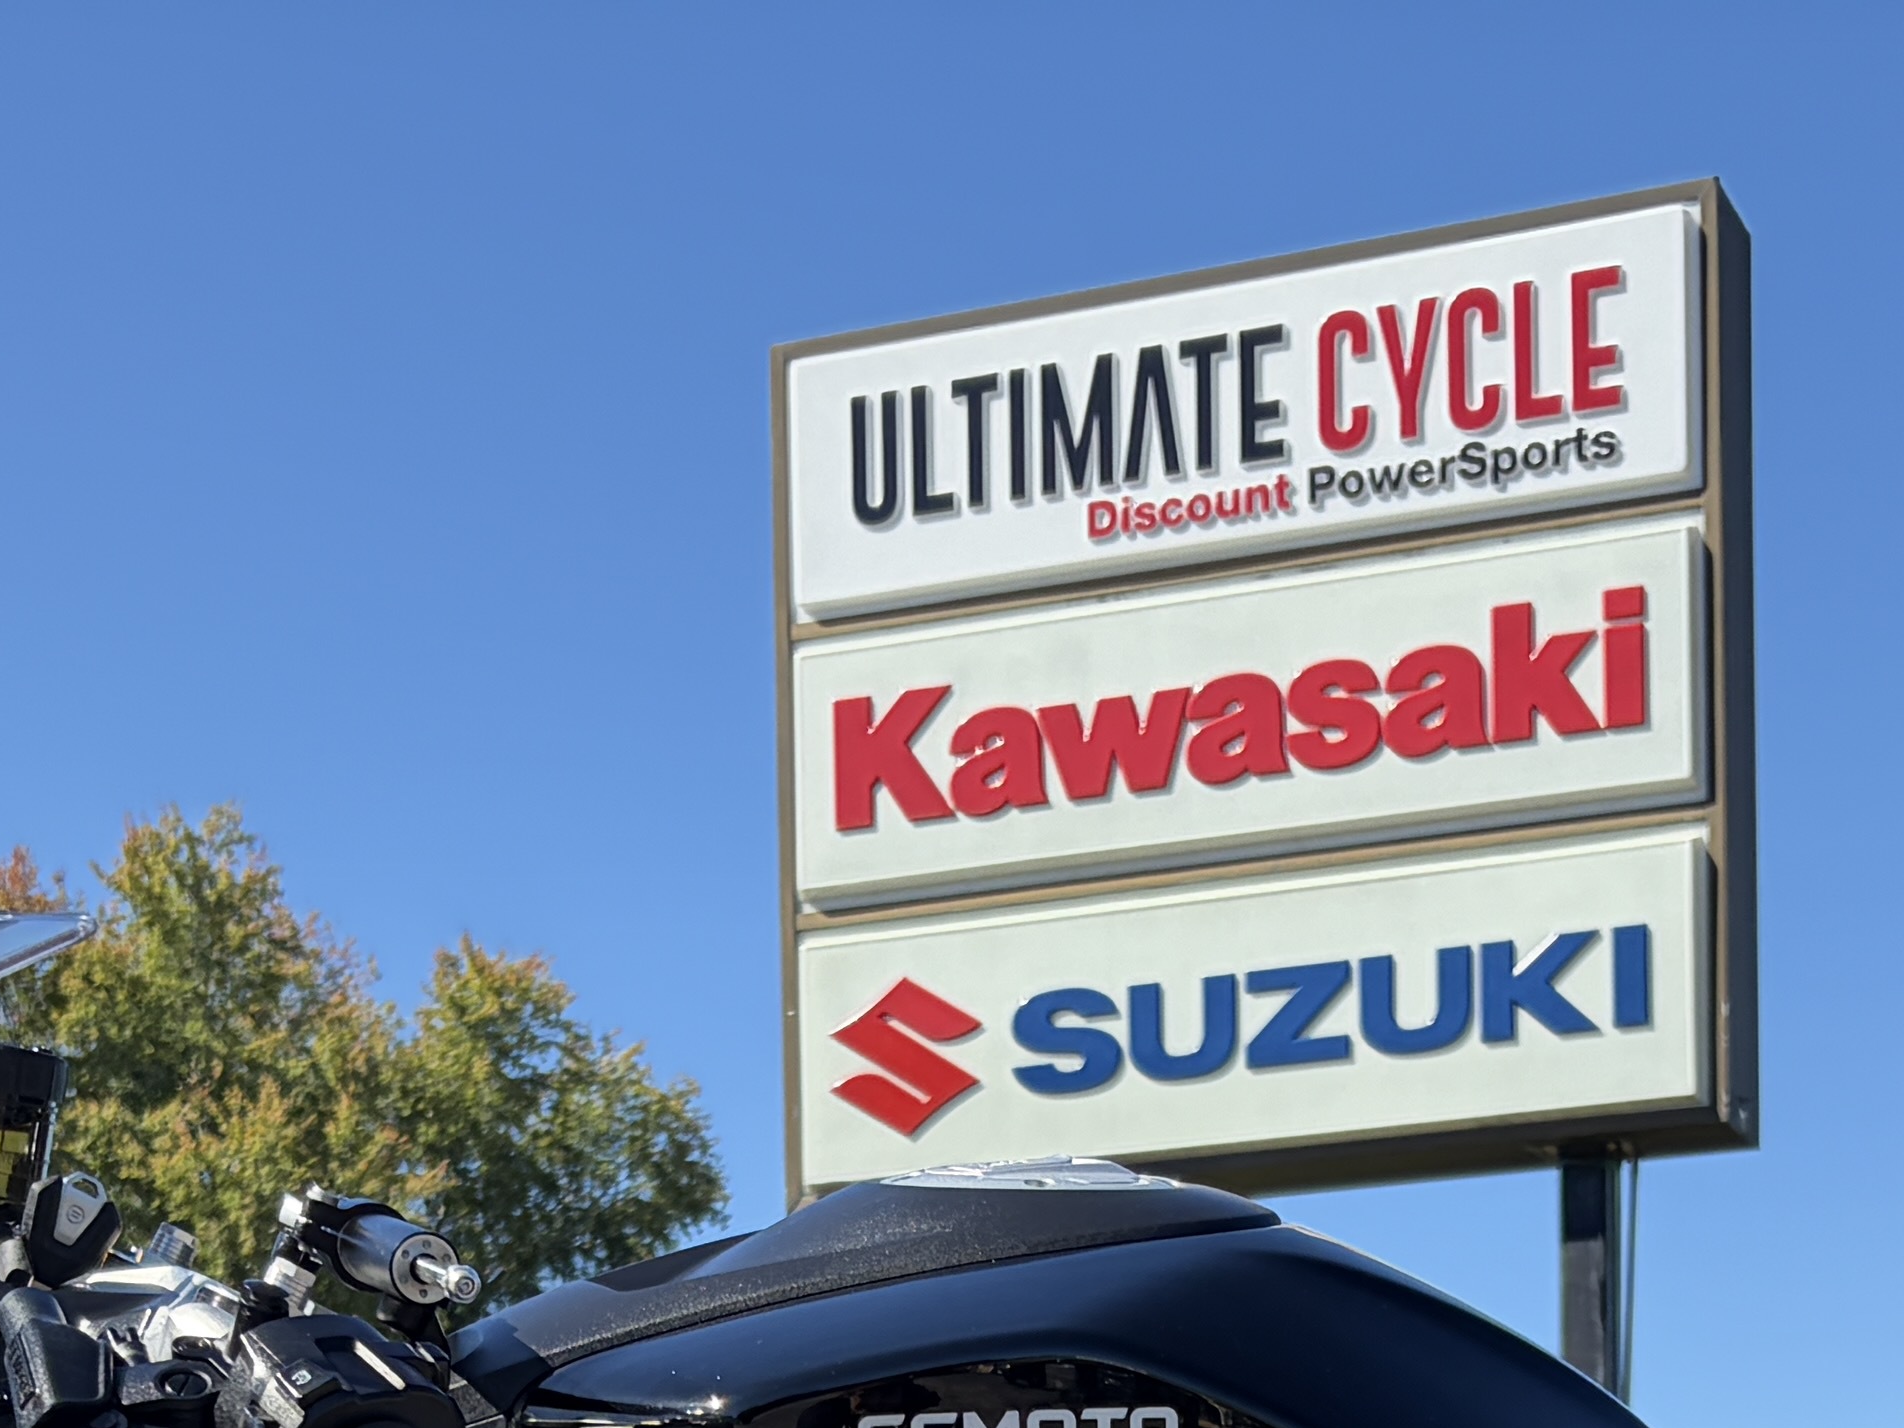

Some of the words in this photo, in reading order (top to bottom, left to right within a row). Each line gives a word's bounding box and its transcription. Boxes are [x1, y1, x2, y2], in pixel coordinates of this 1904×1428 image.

[849, 324, 1290, 526] ULTIMATE
[1317, 266, 1625, 452] CYCLE
[1087, 475, 1292, 541] Discount
[1308, 426, 1620, 506] PowerSports
[832, 585, 1648, 832] Kawasaki
[1012, 922, 1651, 1096] SUZUKI
